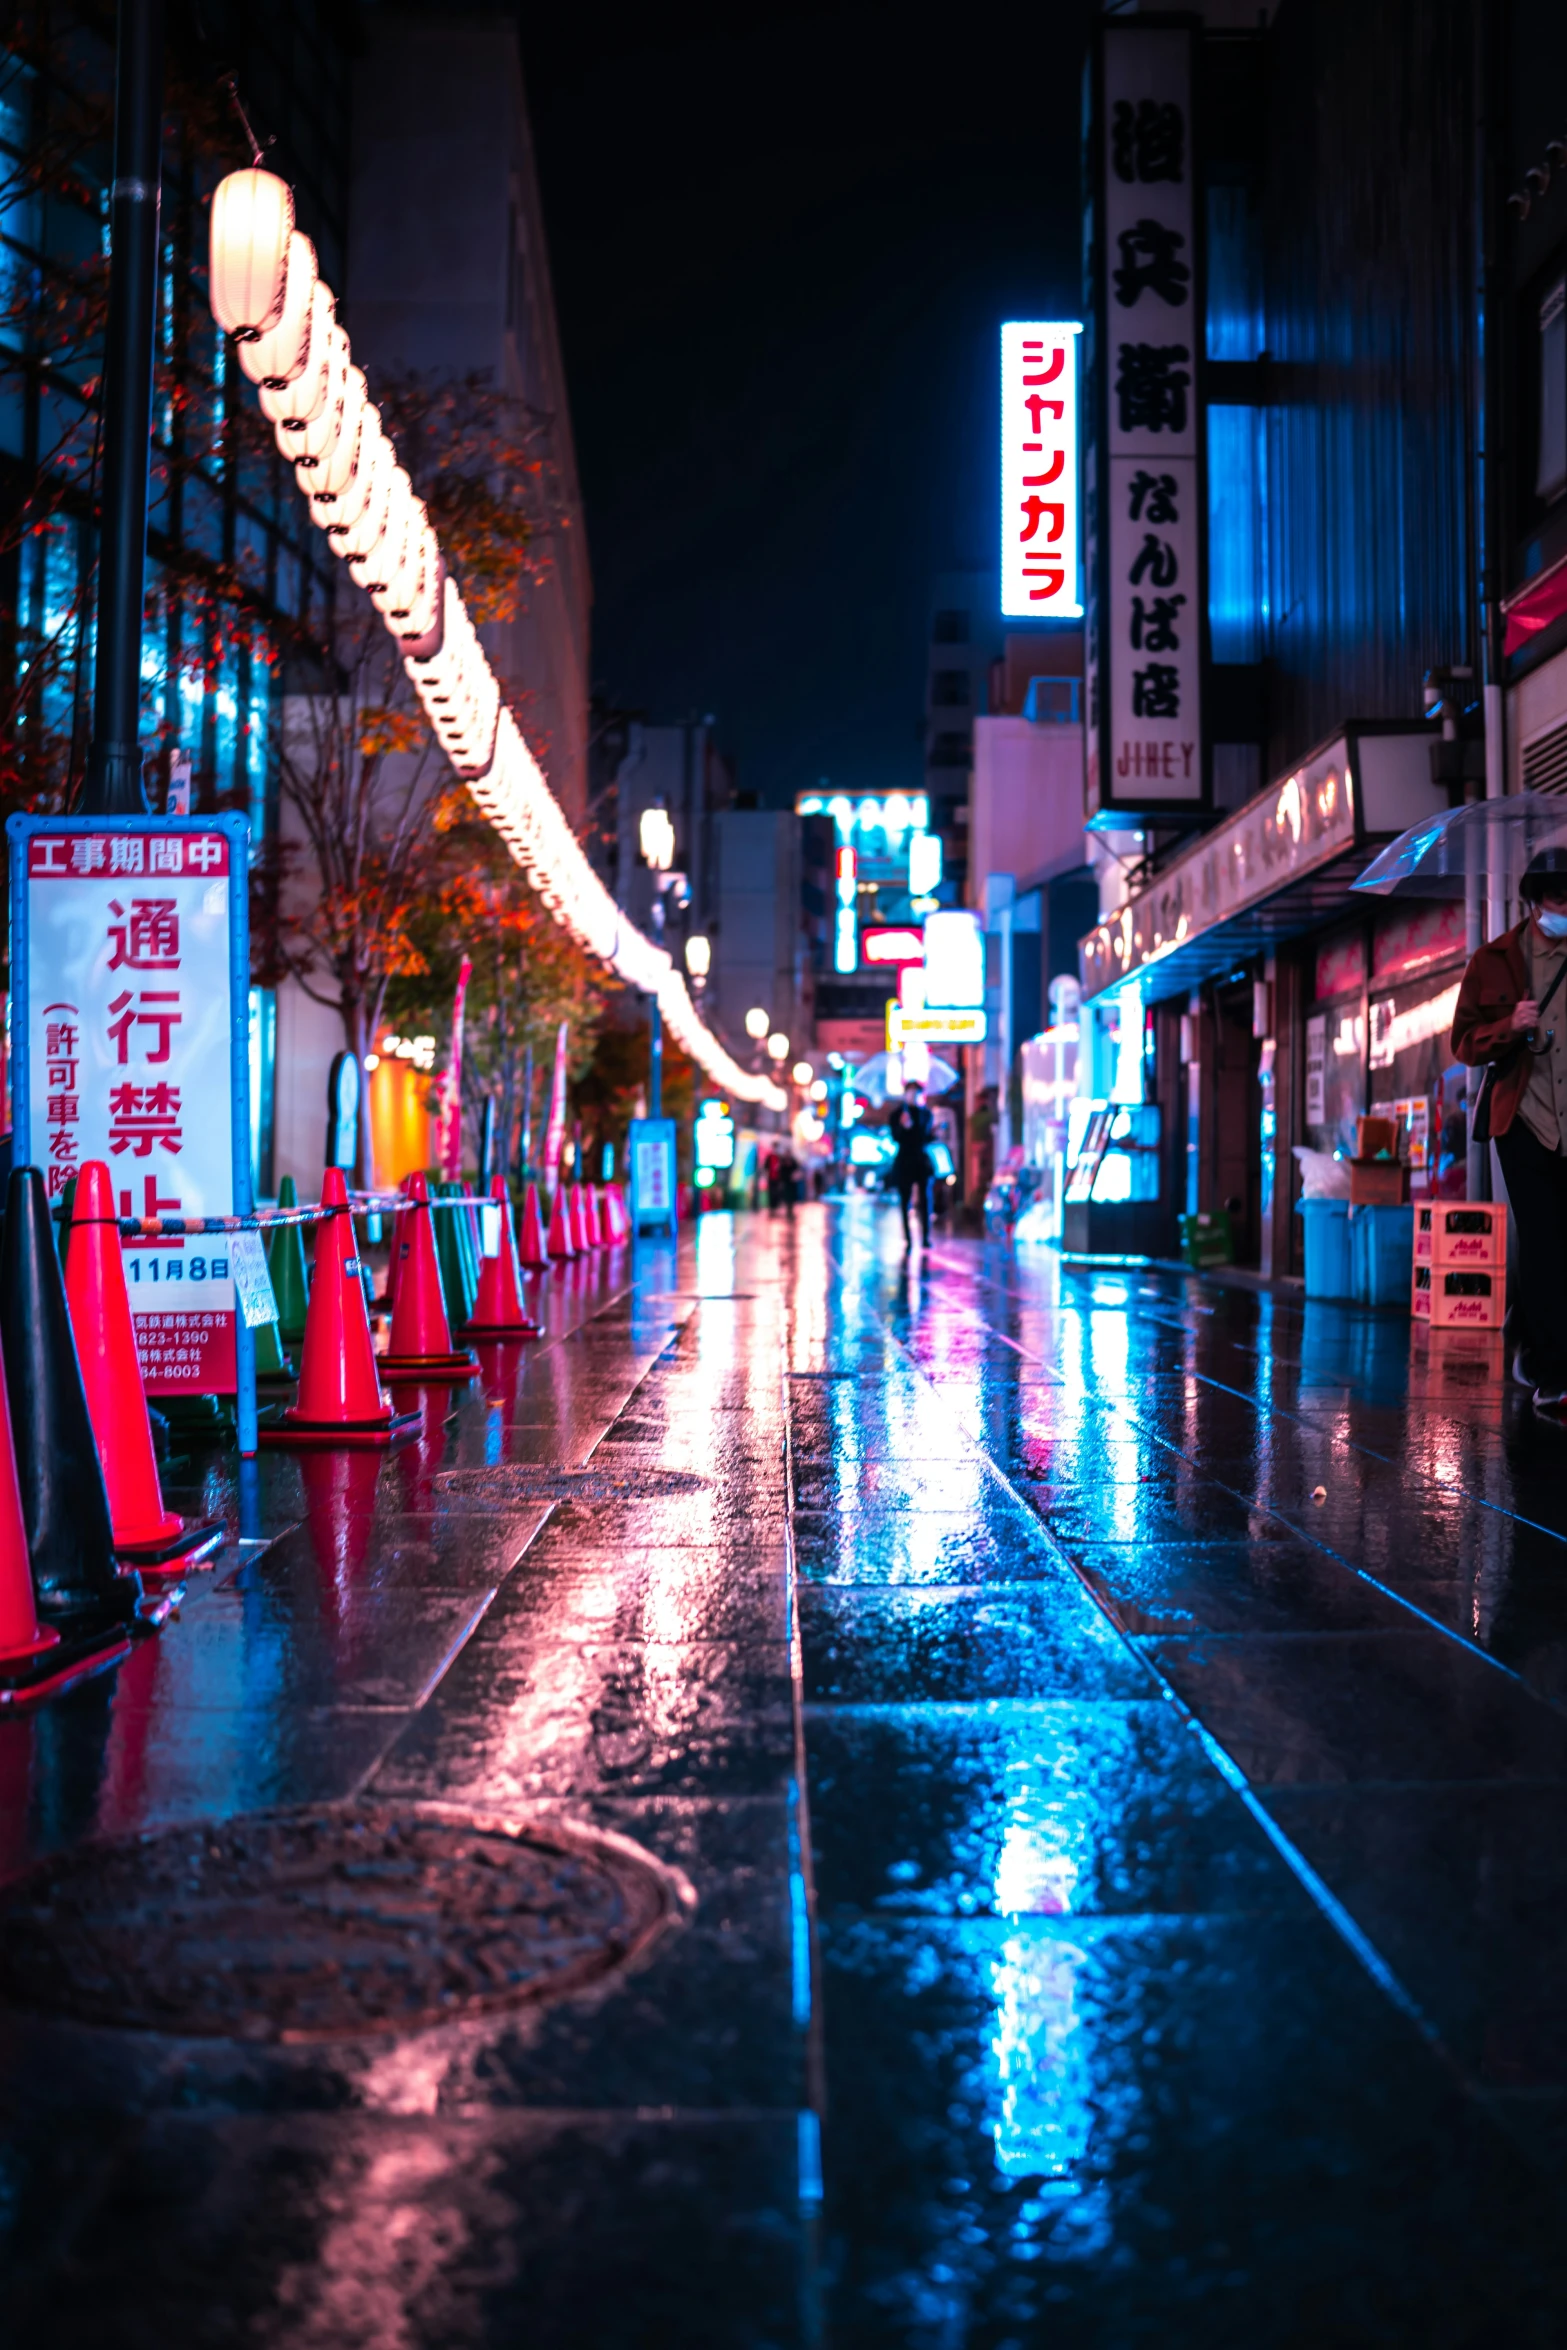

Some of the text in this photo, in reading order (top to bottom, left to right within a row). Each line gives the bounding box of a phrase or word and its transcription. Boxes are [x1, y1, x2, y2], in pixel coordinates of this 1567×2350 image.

[1128, 470, 1187, 719] なんば店
[1117, 741, 1195, 778] JIHEY
[32, 837, 223, 873] 工事期間中
[107, 899, 183, 1250] 通行禁止
[129, 1257, 228, 1282] 11月8日
[136, 1331, 209, 1346] 823-1390
